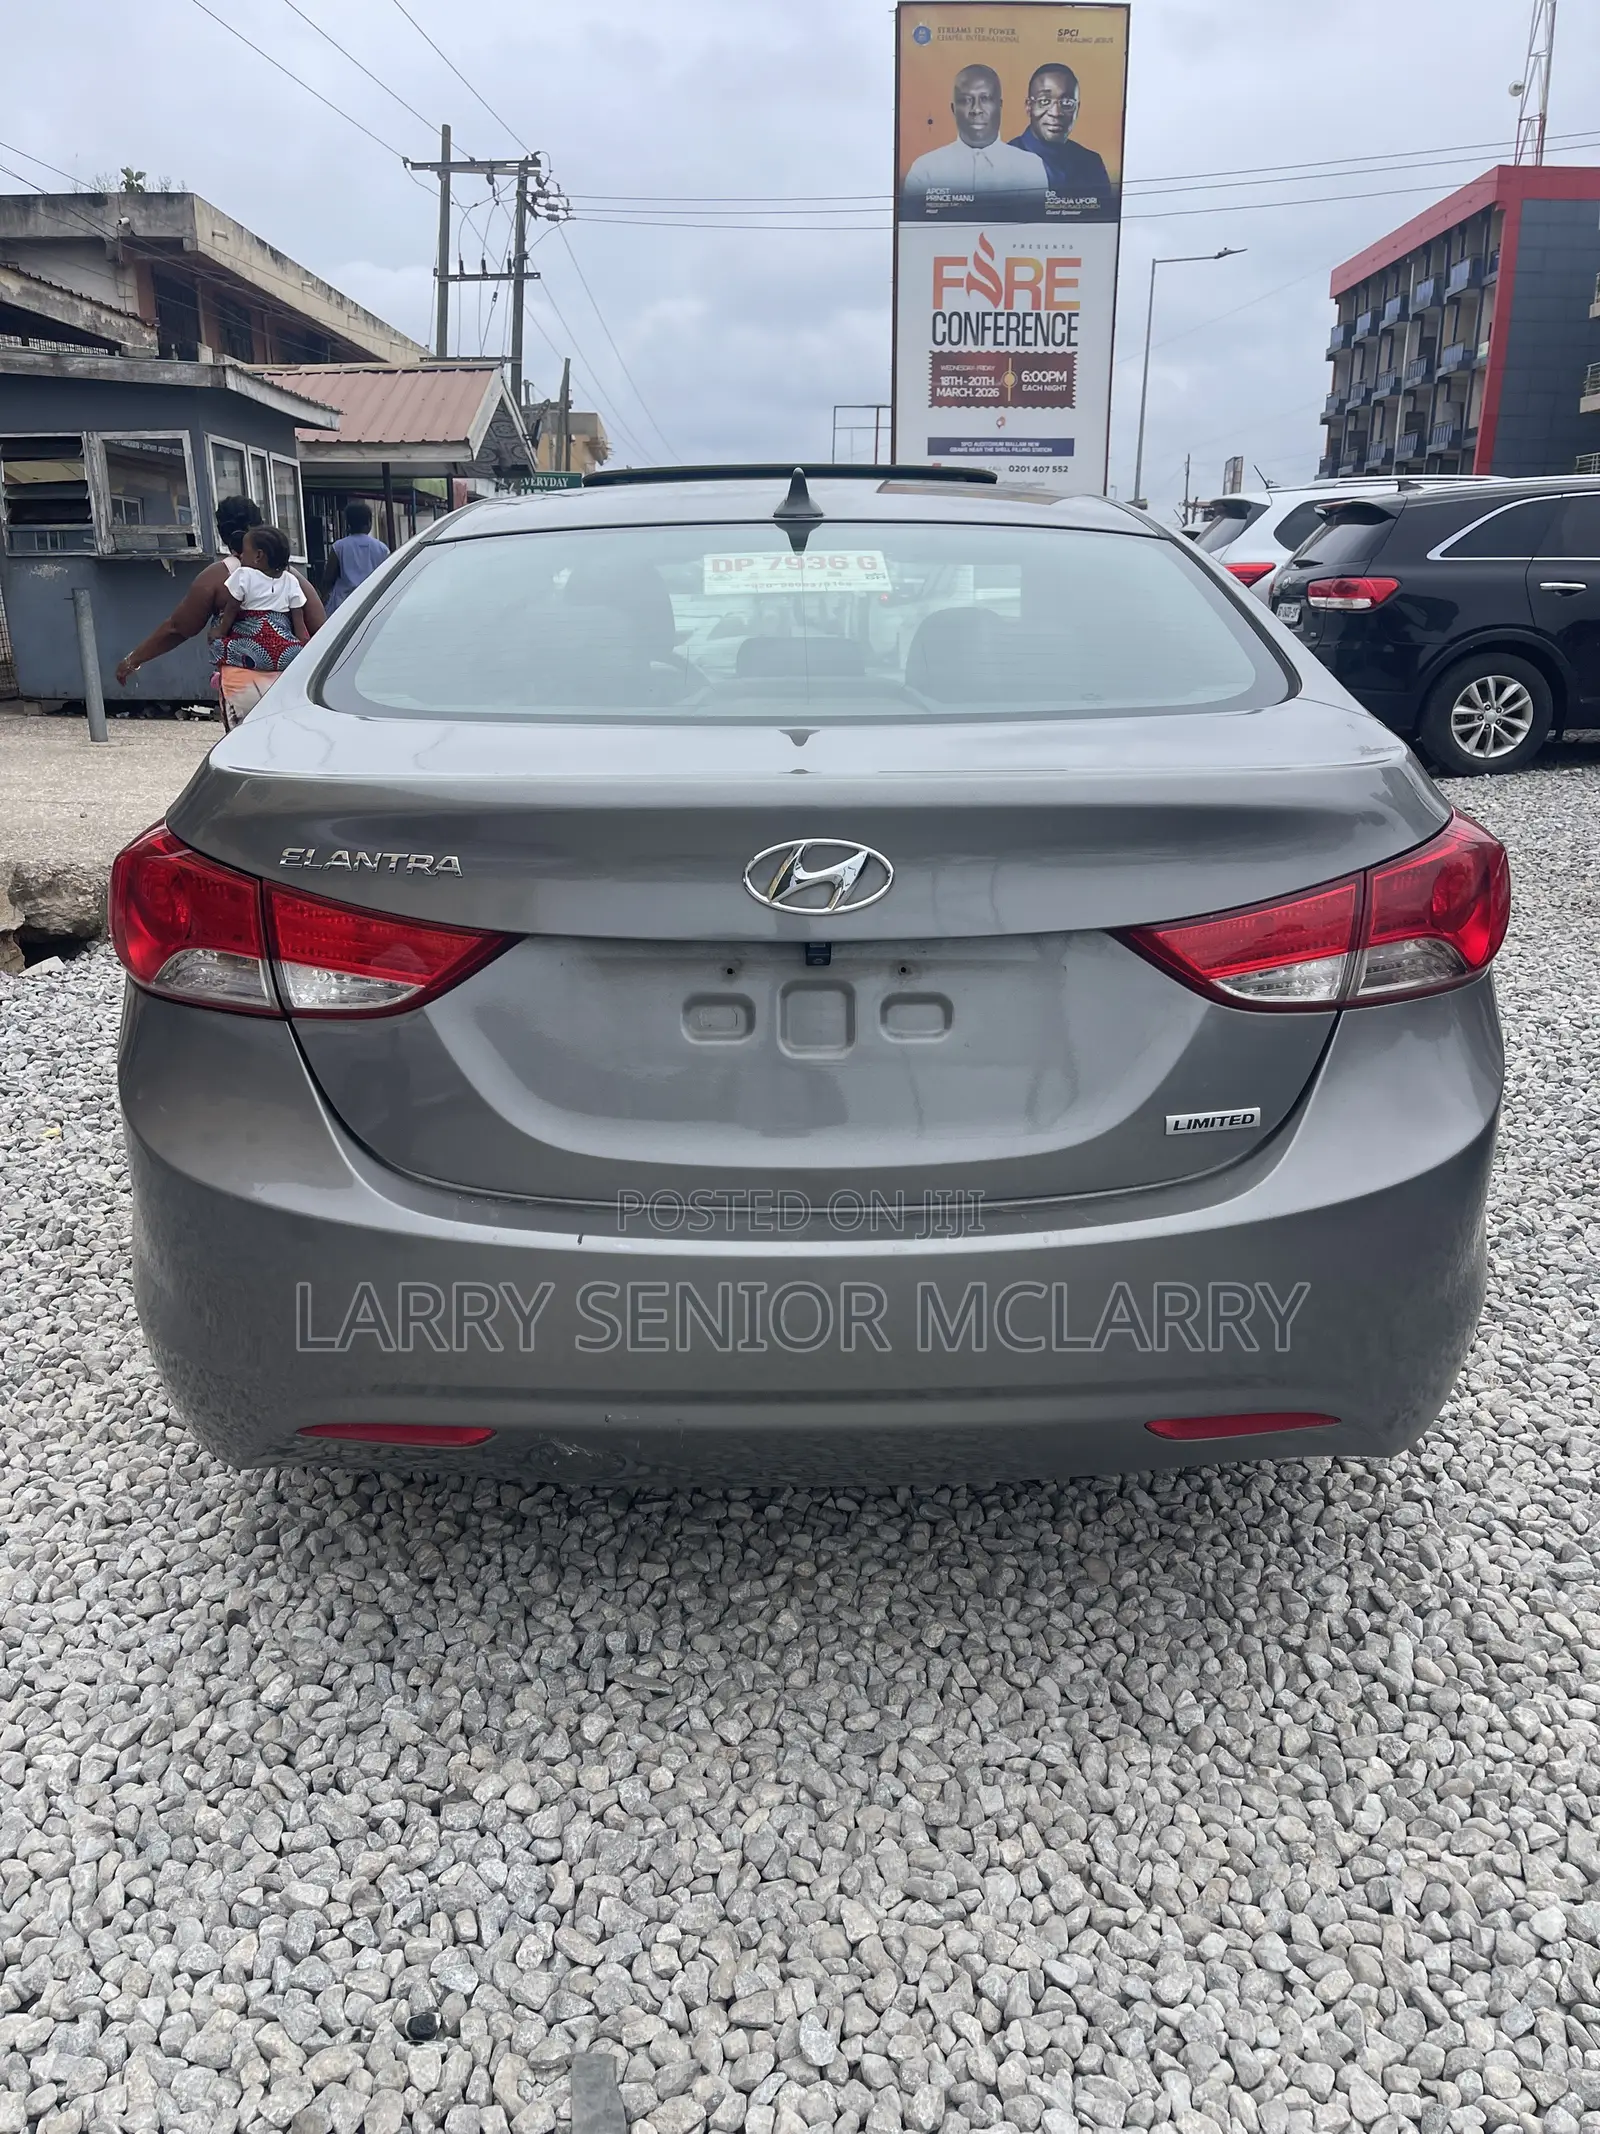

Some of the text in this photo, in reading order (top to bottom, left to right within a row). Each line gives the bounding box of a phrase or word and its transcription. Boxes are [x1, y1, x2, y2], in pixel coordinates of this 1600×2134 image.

[1057, 28, 1080, 37] SPCI
[926, 194, 975, 202] PRINCE MANU
[932, 311, 1080, 347] CONFERENCE
[1021, 371, 1067, 383] 6:00PM
[975, 387, 1000, 397] 2026
[1022, 384, 1067, 392] EACH NIGHT
[1008, 465, 1031, 473] 0201
[1032, 465, 1050, 473] 407
[1052, 465, 1069, 473] 552
[711, 555, 878, 573] DP 7936 G
[279, 847, 464, 878] ELANTRA
[1173, 1113, 1255, 1131] LIMITED
